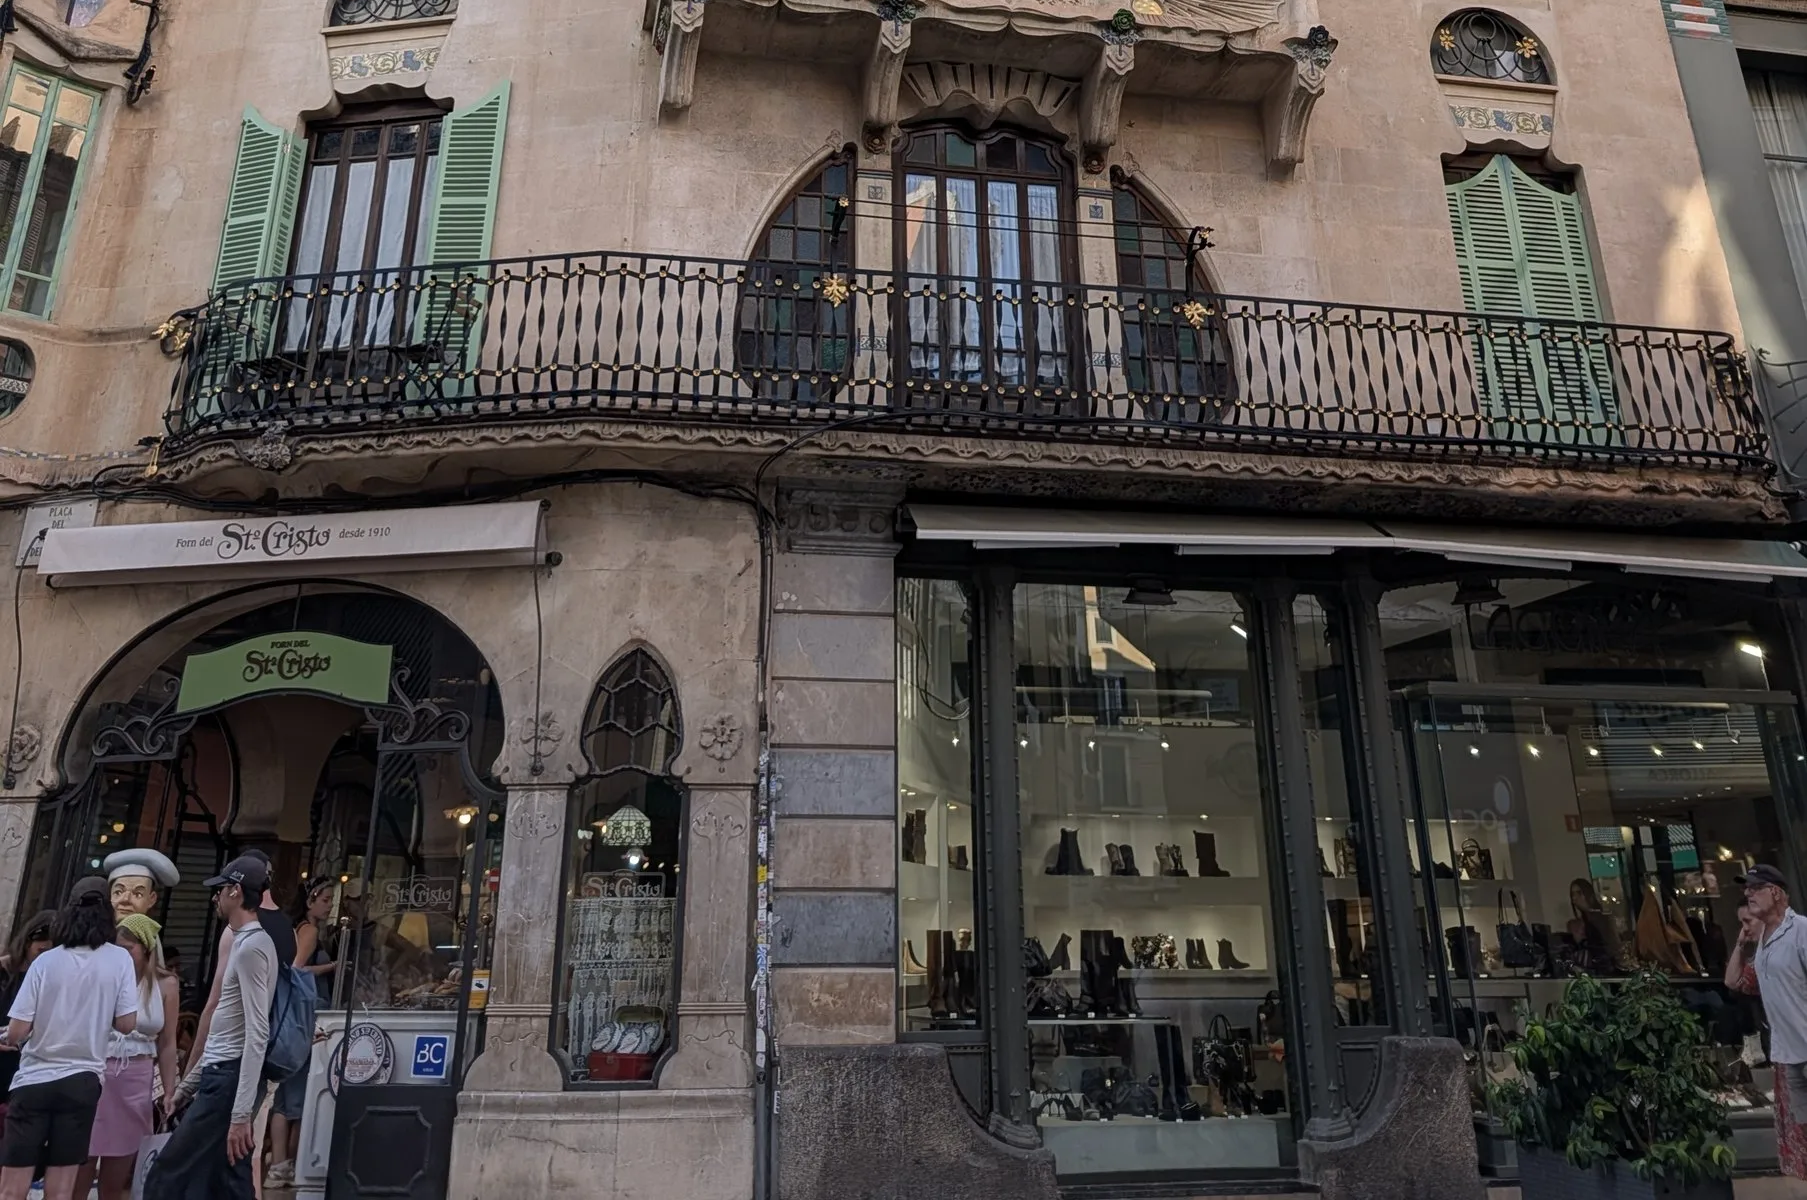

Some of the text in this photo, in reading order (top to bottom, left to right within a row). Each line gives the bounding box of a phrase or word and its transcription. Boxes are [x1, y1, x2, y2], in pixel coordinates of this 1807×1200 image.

[175, 538, 197, 548] Forn
[199, 536, 214, 547] del
[261, 520, 332, 557] Cristo
[338, 528, 366, 539] desde
[368, 526, 391, 538] 1910
[270, 639, 311, 649] FORN DEL
[277, 648, 332, 680] Cristo
[410, 883, 453, 908] Cristo
[614, 876, 662, 898] Cristo
